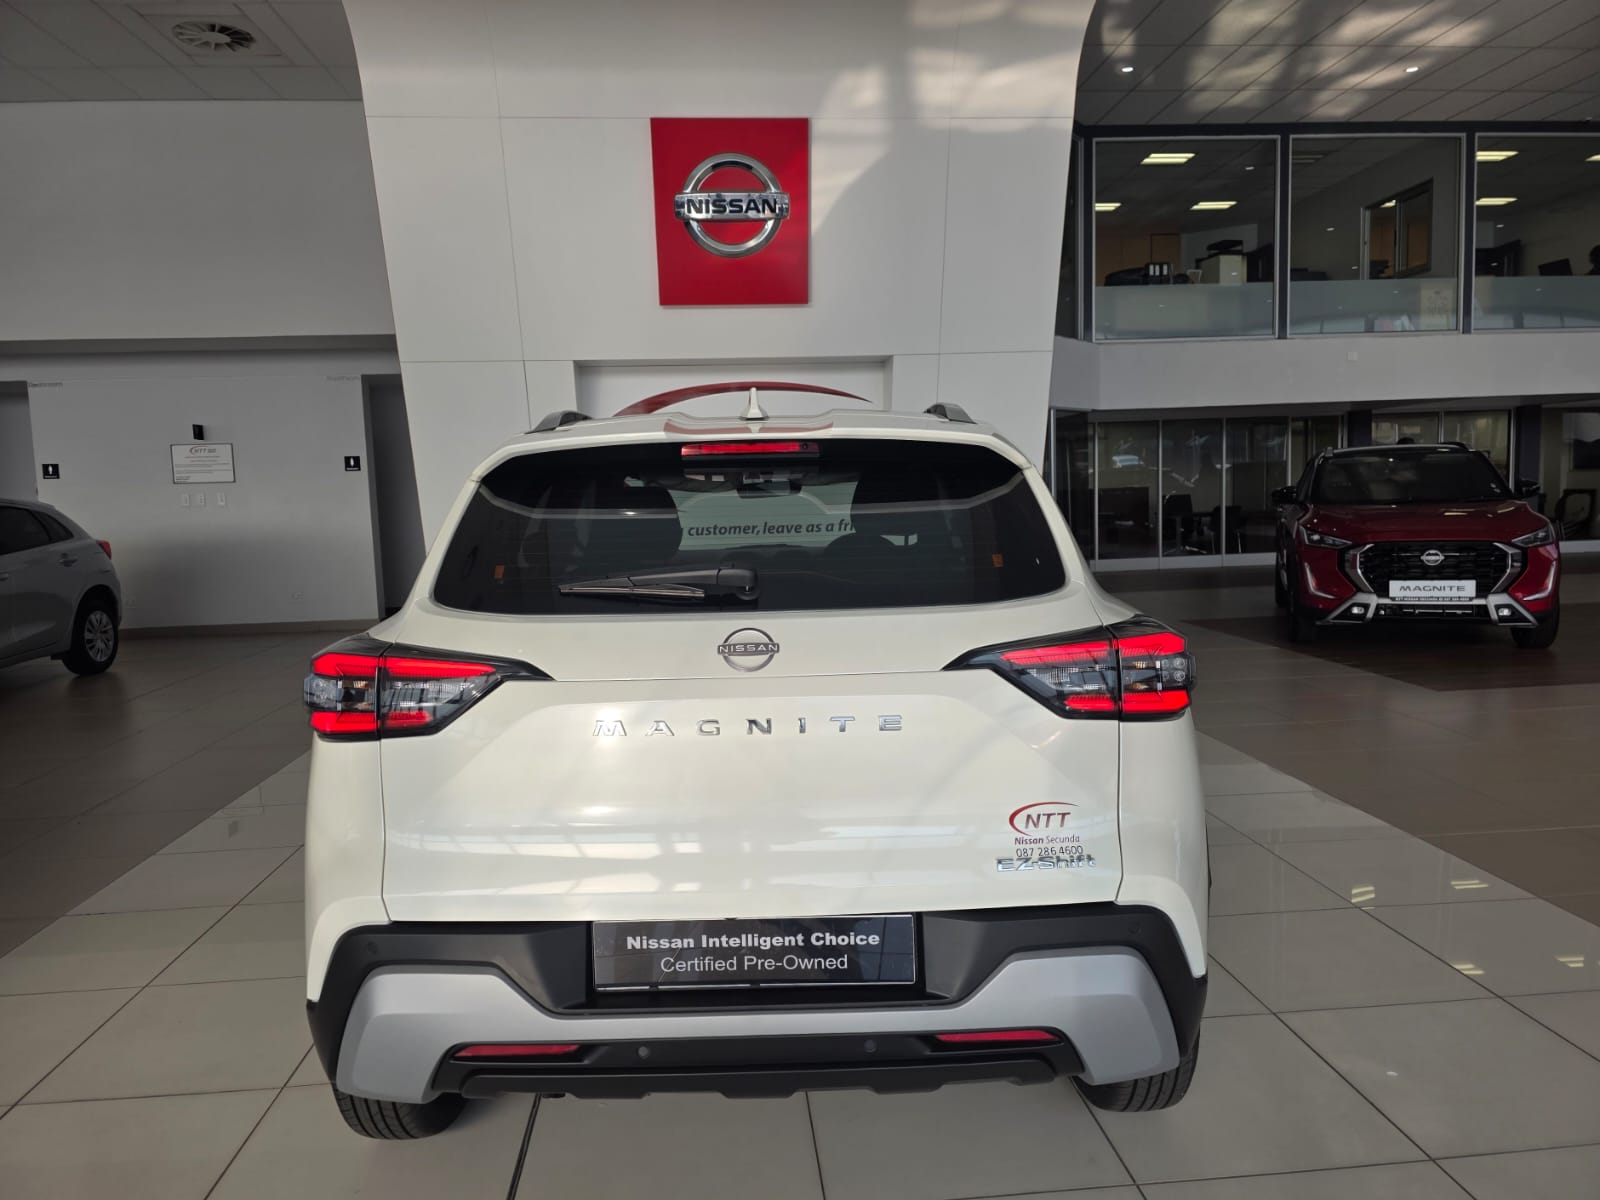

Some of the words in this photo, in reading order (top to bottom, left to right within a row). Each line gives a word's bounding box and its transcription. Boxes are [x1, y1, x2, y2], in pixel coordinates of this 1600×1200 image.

[686, 198, 777, 214] NISSAN
[688, 523, 761, 536] customer,
[762, 521, 803, 535] leave
[805, 522, 822, 533] as
[825, 521, 835, 532] a
[719, 644, 778, 653] NISSAN
[592, 715, 903, 737] MAGNITE
[1025, 812, 1071, 829] NTT
[1014, 836, 1044, 846] Nissan
[1046, 834, 1080, 844] Secunda
[1016, 848, 1034, 858] 087
[1038, 846, 1057, 857] 286
[1059, 845, 1084, 855] 4600
[996, 854, 1097, 872] EZ-Shift
[627, 936, 695, 950] Nissan
[701, 933, 805, 950] Intelligent
[810, 932, 880, 946] Choice
[660, 956, 737, 972] Certified
[744, 954, 848, 970] Pre-Owned
